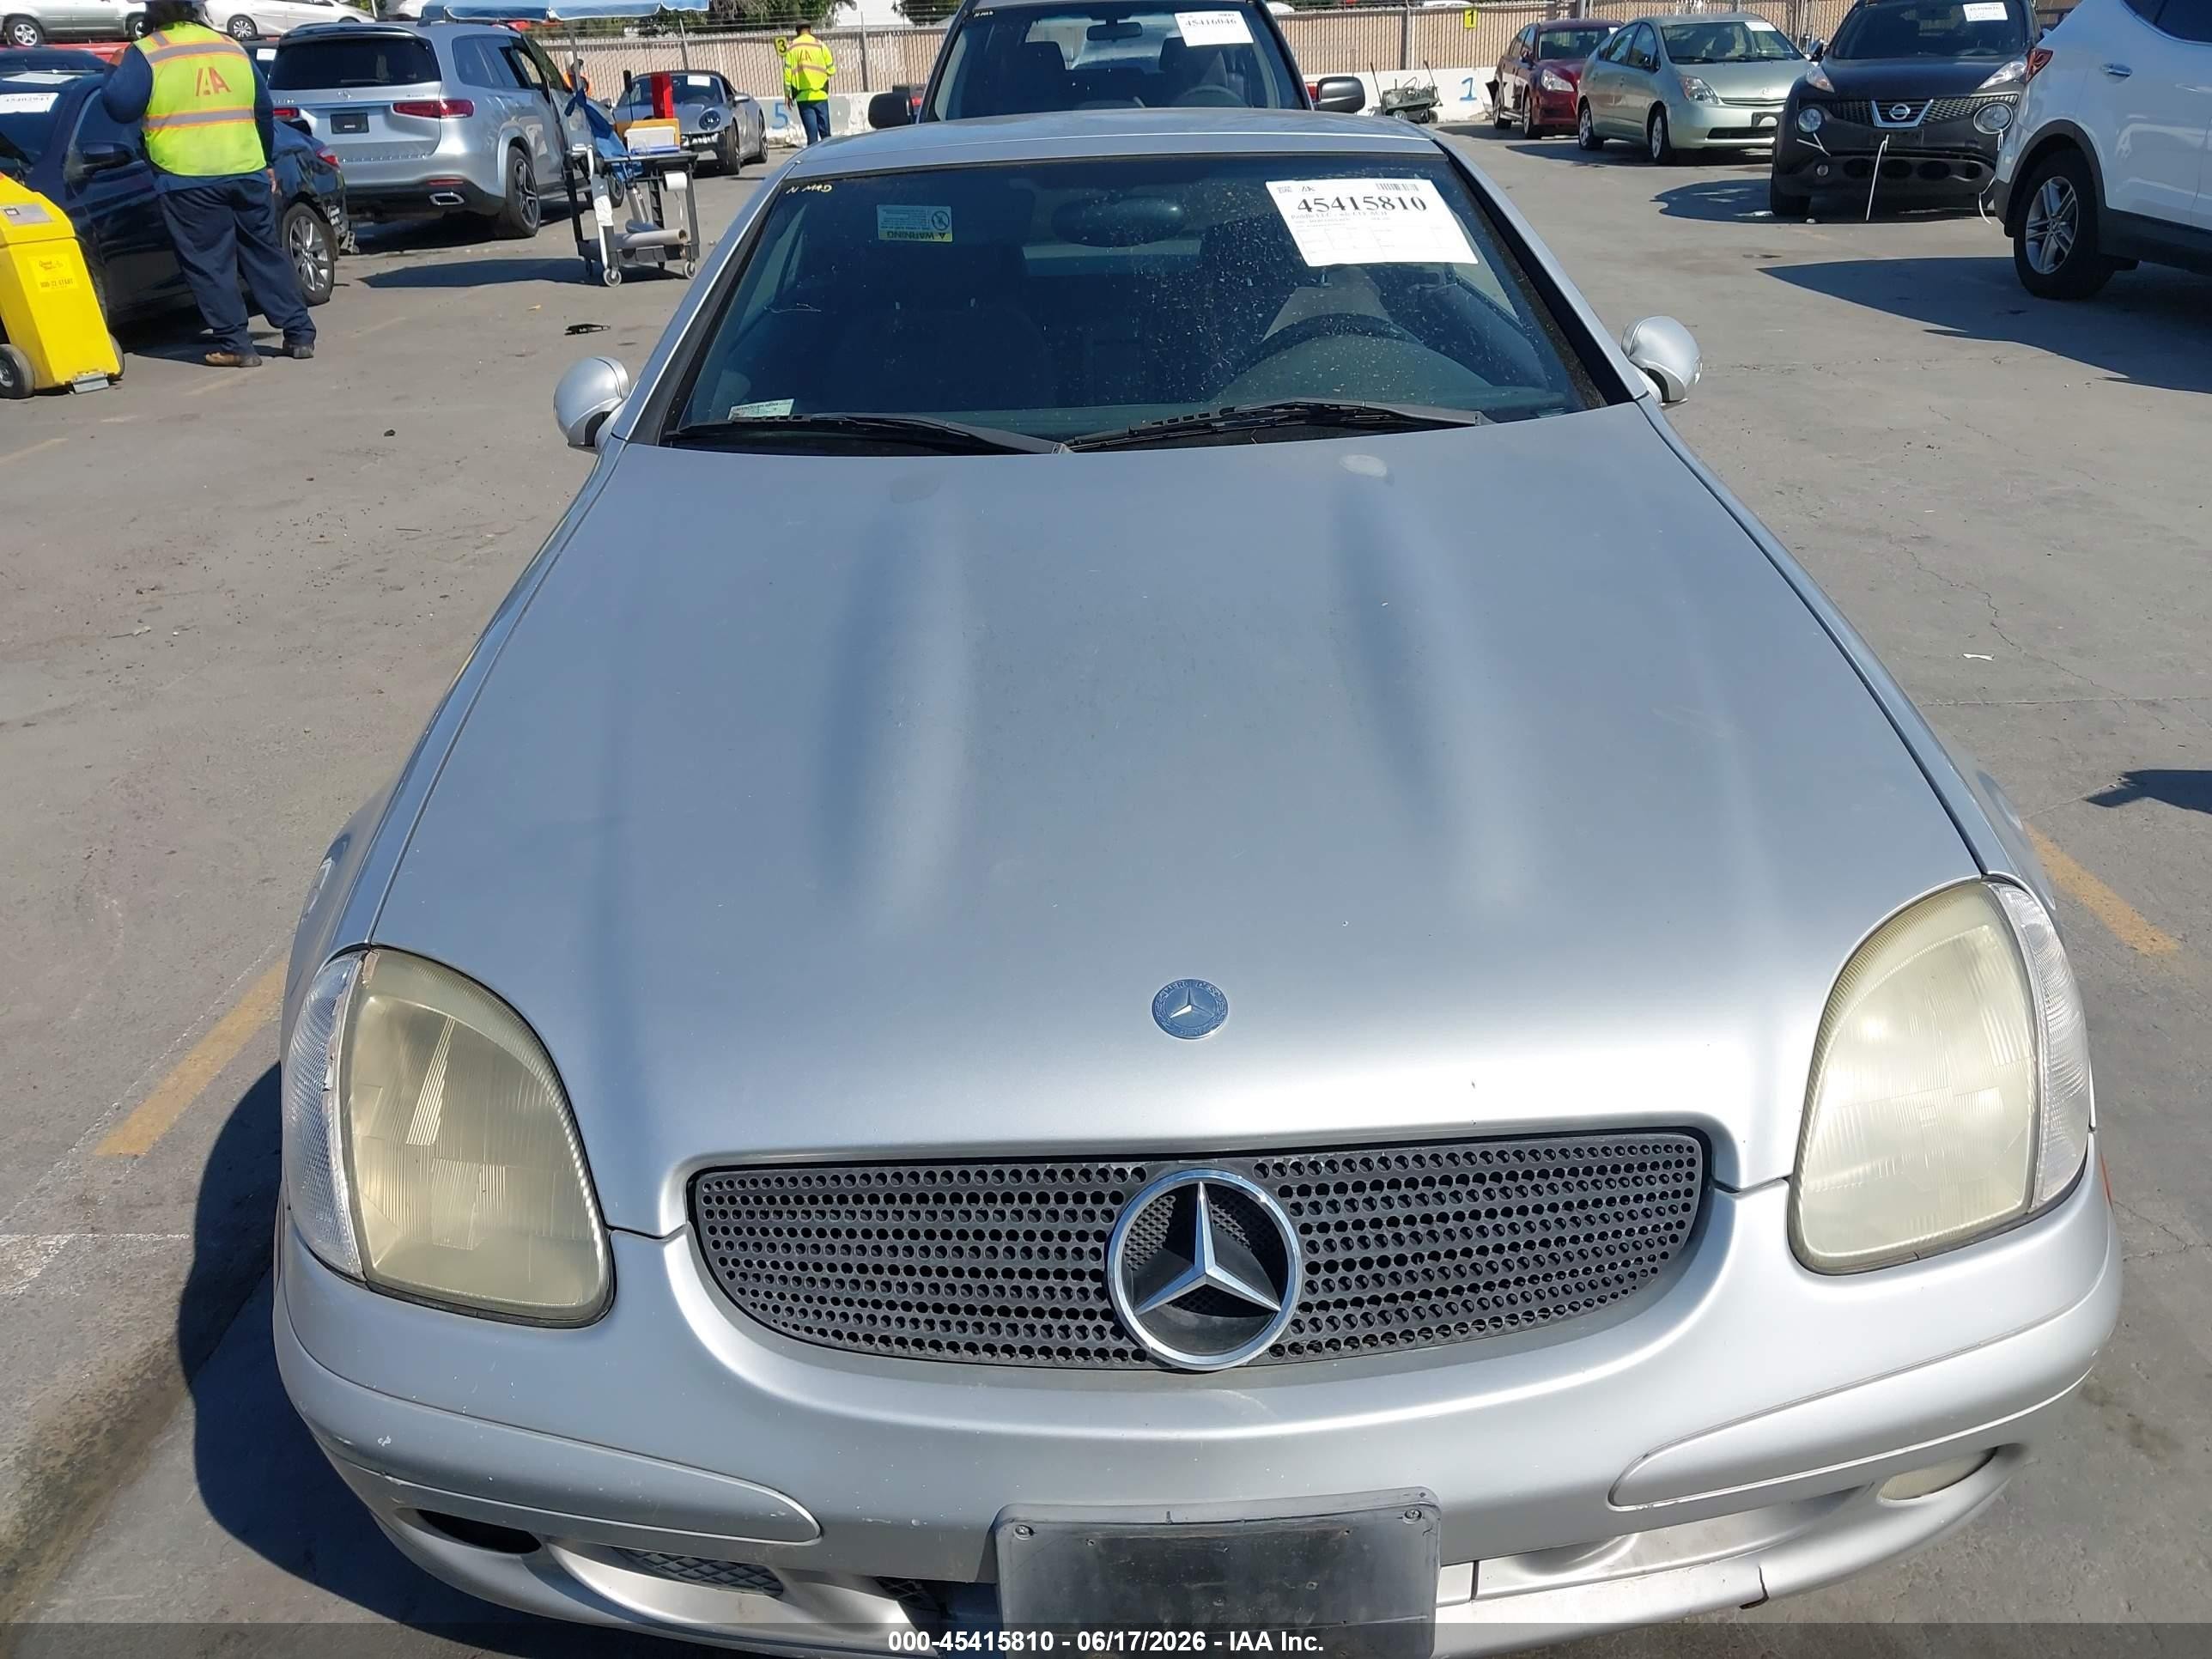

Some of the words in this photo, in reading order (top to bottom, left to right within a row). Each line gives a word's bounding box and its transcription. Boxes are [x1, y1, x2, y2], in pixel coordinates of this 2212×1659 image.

[1468, 9, 1474, 25] 1
[777, 39, 787, 53] 3
[1459, 76, 1478, 101] 1
[771, 100, 789, 130] 5
[1297, 195, 1427, 213] 45415810
[886, 230, 934, 240] WARNING
